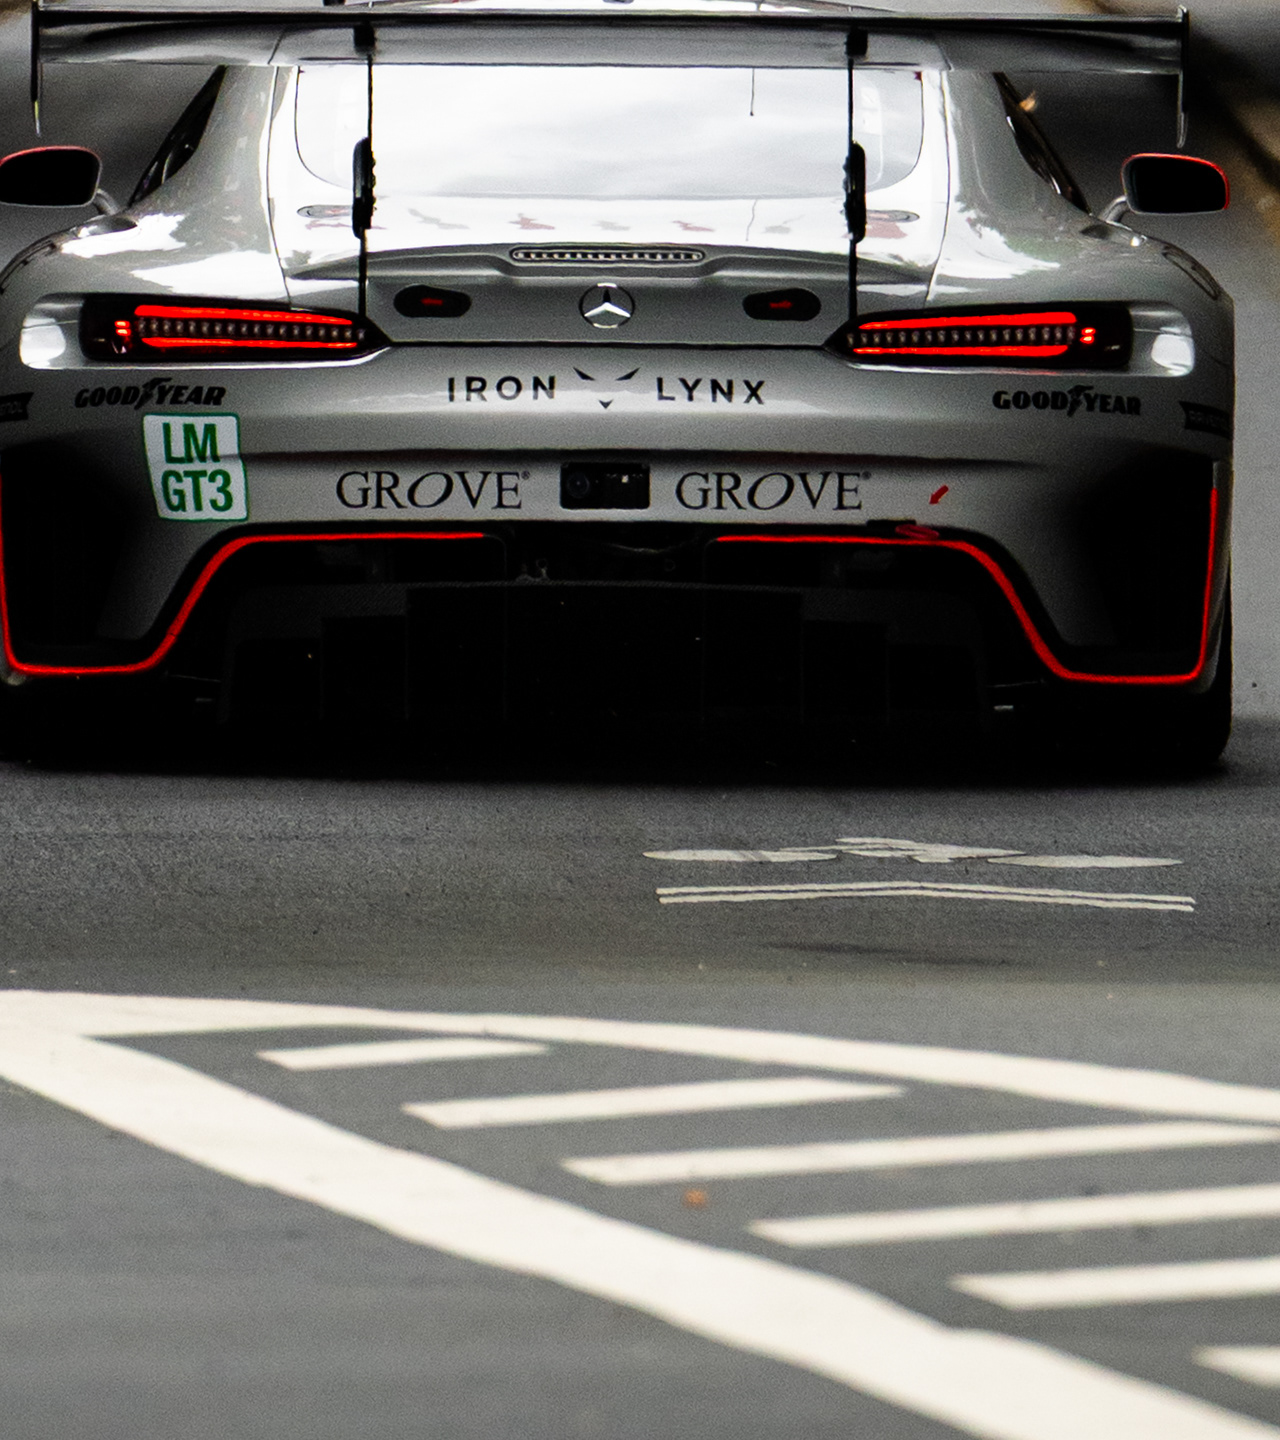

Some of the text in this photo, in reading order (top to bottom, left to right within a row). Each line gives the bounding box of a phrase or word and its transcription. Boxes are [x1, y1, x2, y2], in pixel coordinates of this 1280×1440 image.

[74, 377, 226, 410] GOODYEAR
[447, 375, 765, 405] IRON LYNX
[992, 385, 1141, 417] GOODYEAR
[162, 423, 220, 463] LM
[161, 470, 234, 513] GT3
